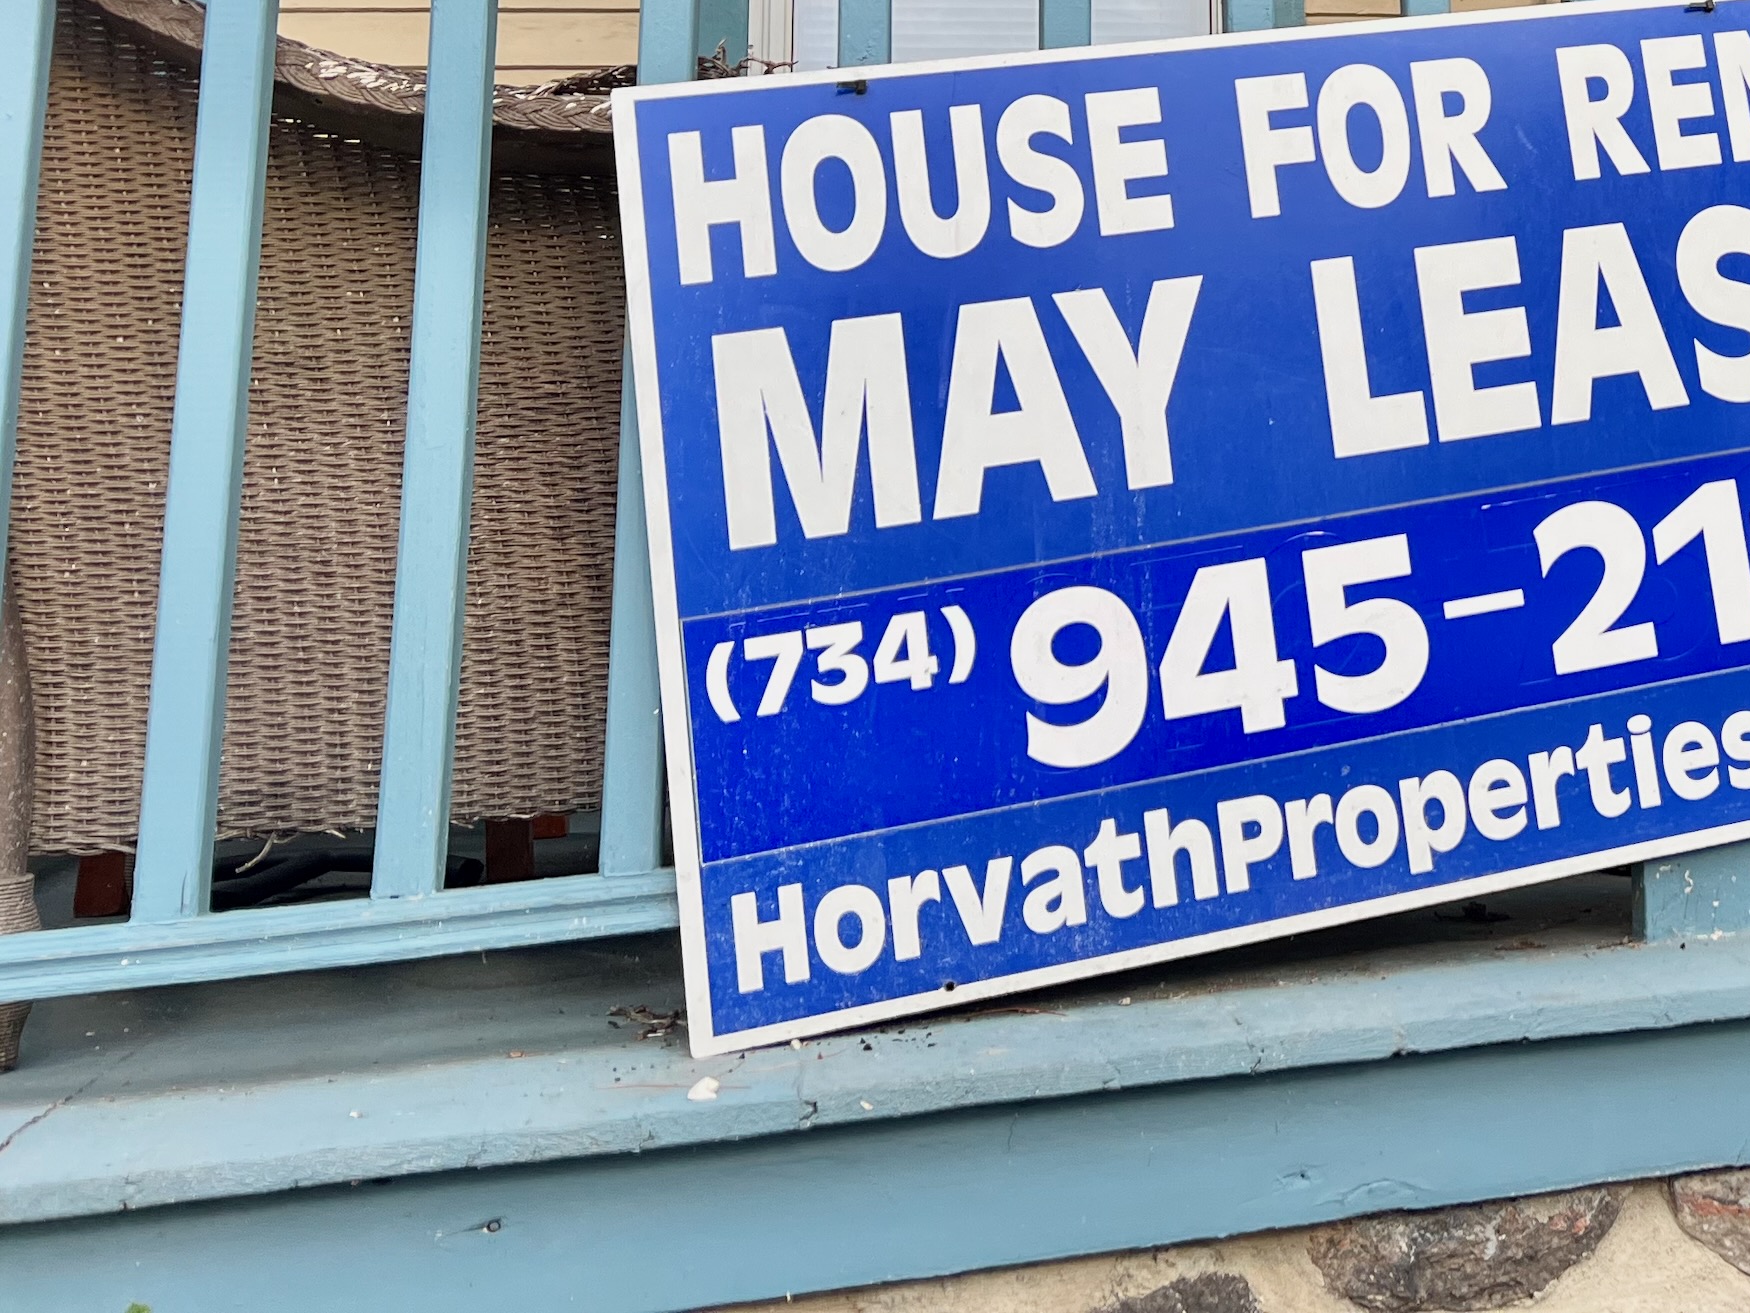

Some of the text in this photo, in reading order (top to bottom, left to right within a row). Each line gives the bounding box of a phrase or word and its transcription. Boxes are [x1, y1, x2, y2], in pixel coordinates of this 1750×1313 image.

[667, 86, 1175, 286] HOUSE
[1234, 57, 1508, 219] FOR
[711, 274, 1204, 551] MAY
[705, 605, 977, 723] (734)
